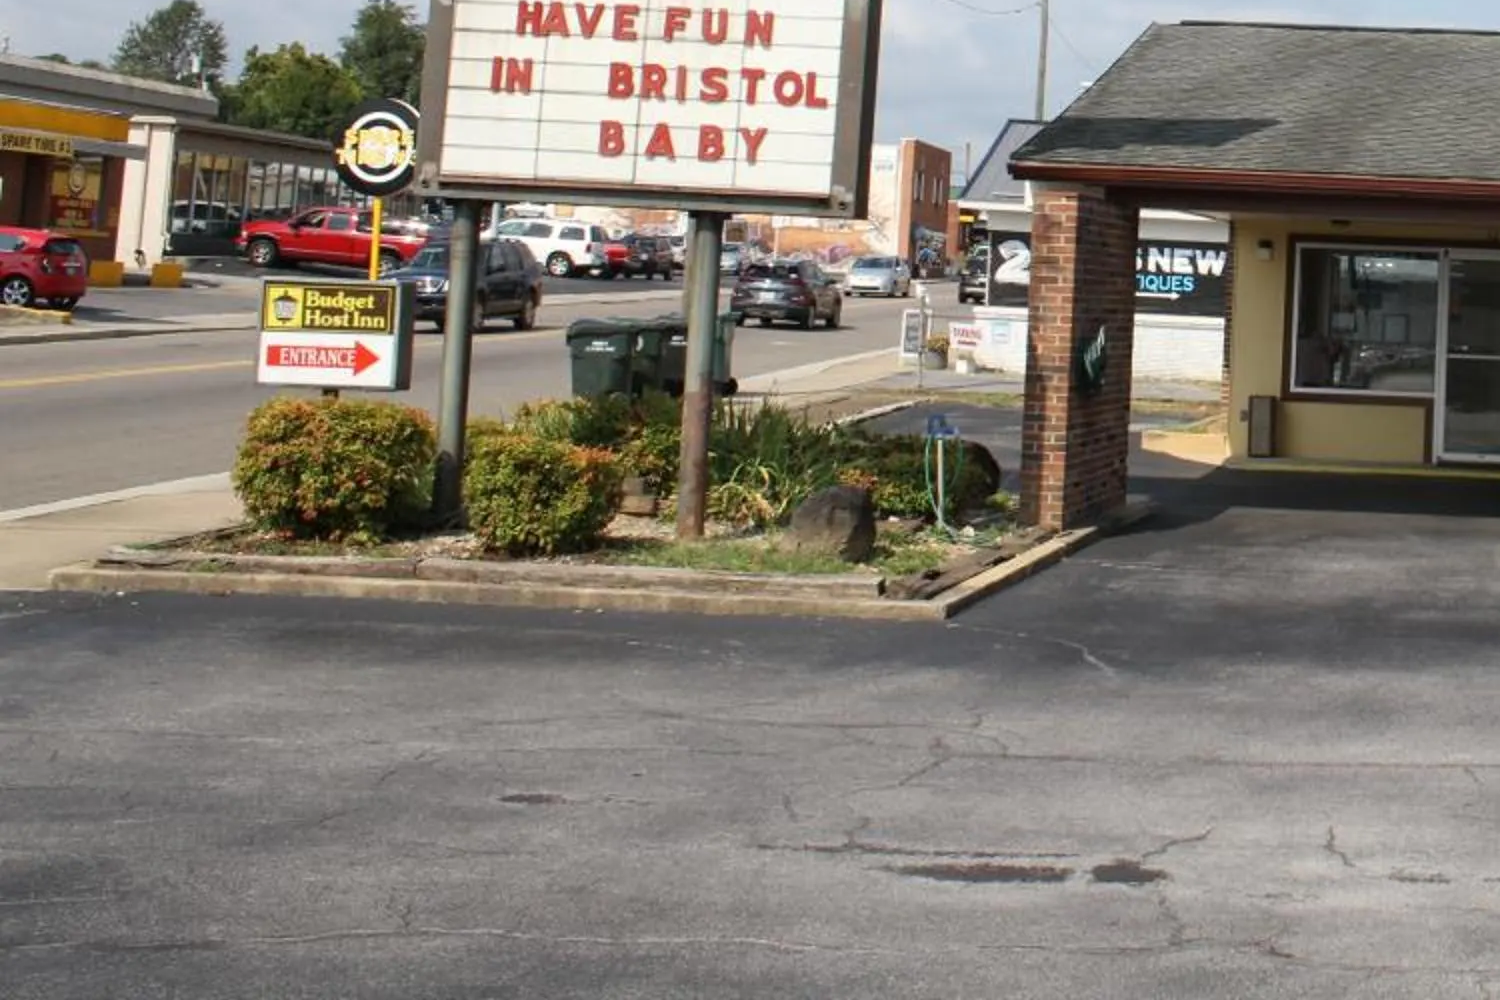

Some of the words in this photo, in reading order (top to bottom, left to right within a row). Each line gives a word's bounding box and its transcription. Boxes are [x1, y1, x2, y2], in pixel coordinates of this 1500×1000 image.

[516, 0, 639, 41] HAVE
[663, 8, 774, 48] FUN
[490, 56, 533, 95] IN
[608, 63, 828, 108] BRISTOL
[598, 120, 769, 166] BABY
[1148, 247, 1227, 276] NEW
[305, 290, 375, 311] Budget
[304, 309, 349, 327] Host
[353, 311, 385, 328] Inn
[279, 347, 356, 367] ENTRANCE
